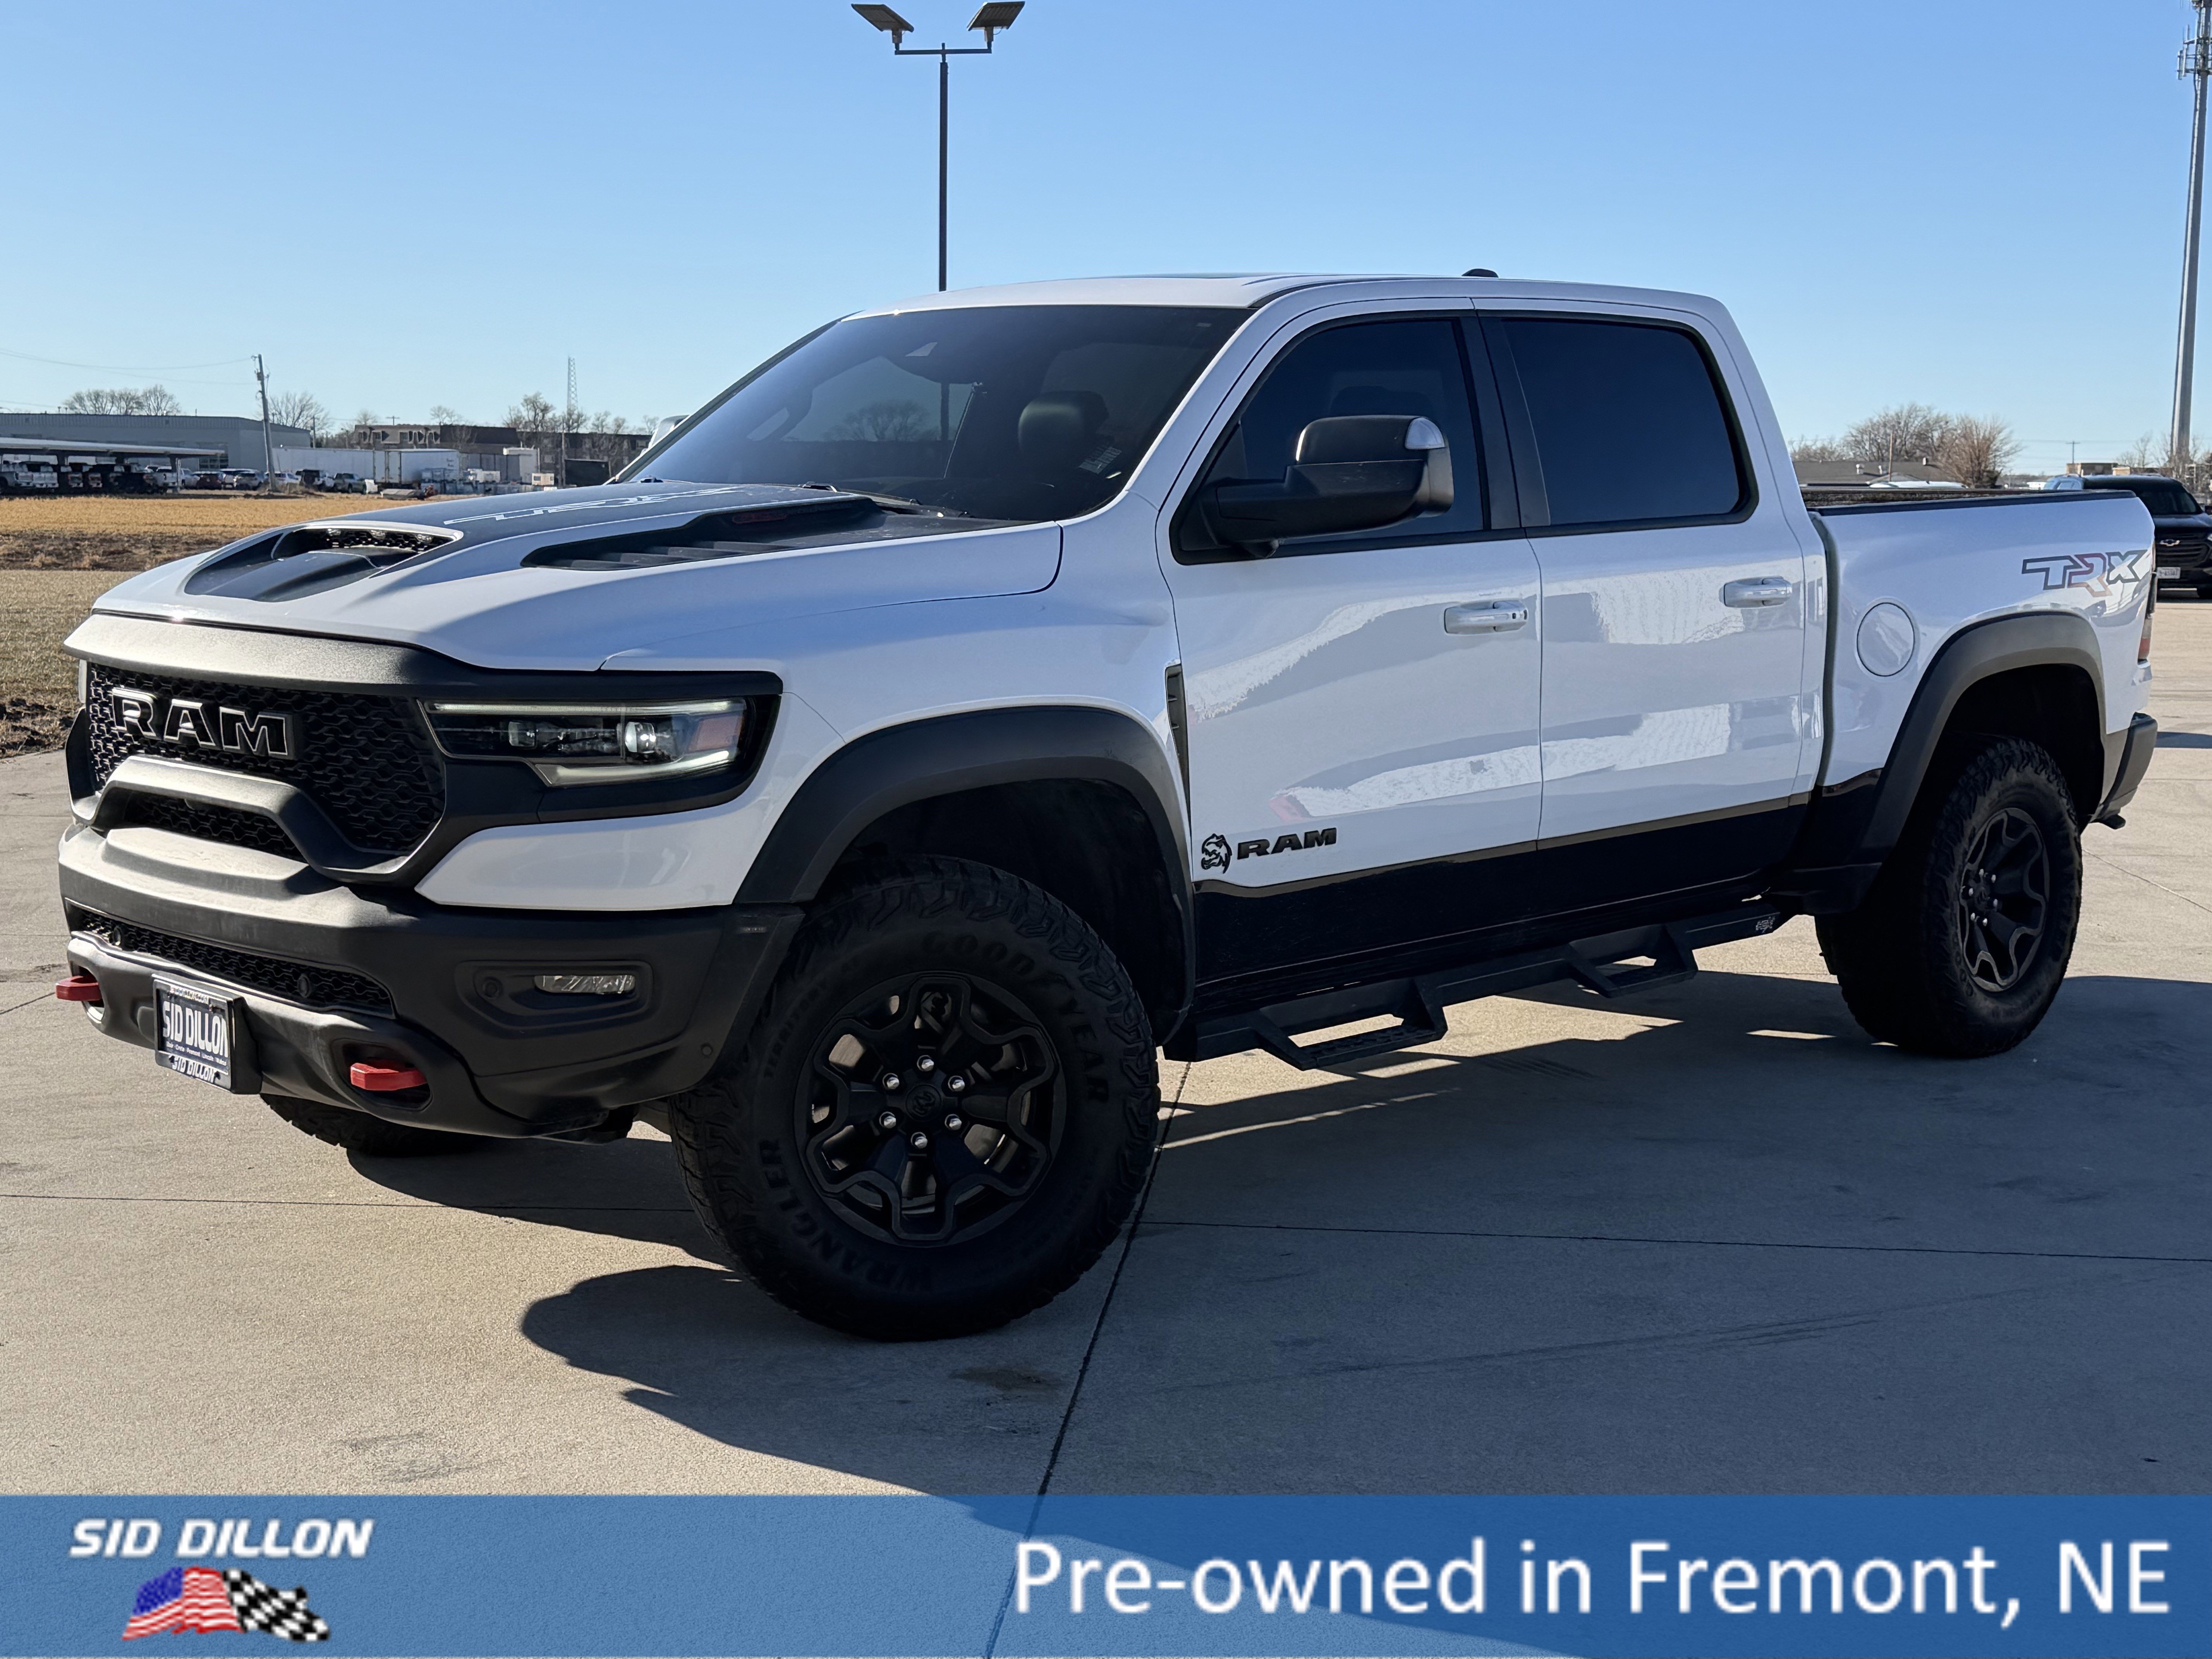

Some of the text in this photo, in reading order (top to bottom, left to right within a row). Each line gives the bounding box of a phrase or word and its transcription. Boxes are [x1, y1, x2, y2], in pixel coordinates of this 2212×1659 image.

[2021, 550, 2148, 597] TRX
[112, 687, 288, 756] RAM
[1237, 828, 1337, 860] RAM
[163, 1001, 228, 1058] SID DILLON
[923, 929, 1109, 1103] GOODYEAR
[172, 1056, 215, 1083] SID DILLON
[758, 1137, 933, 1291] WRANGLER
